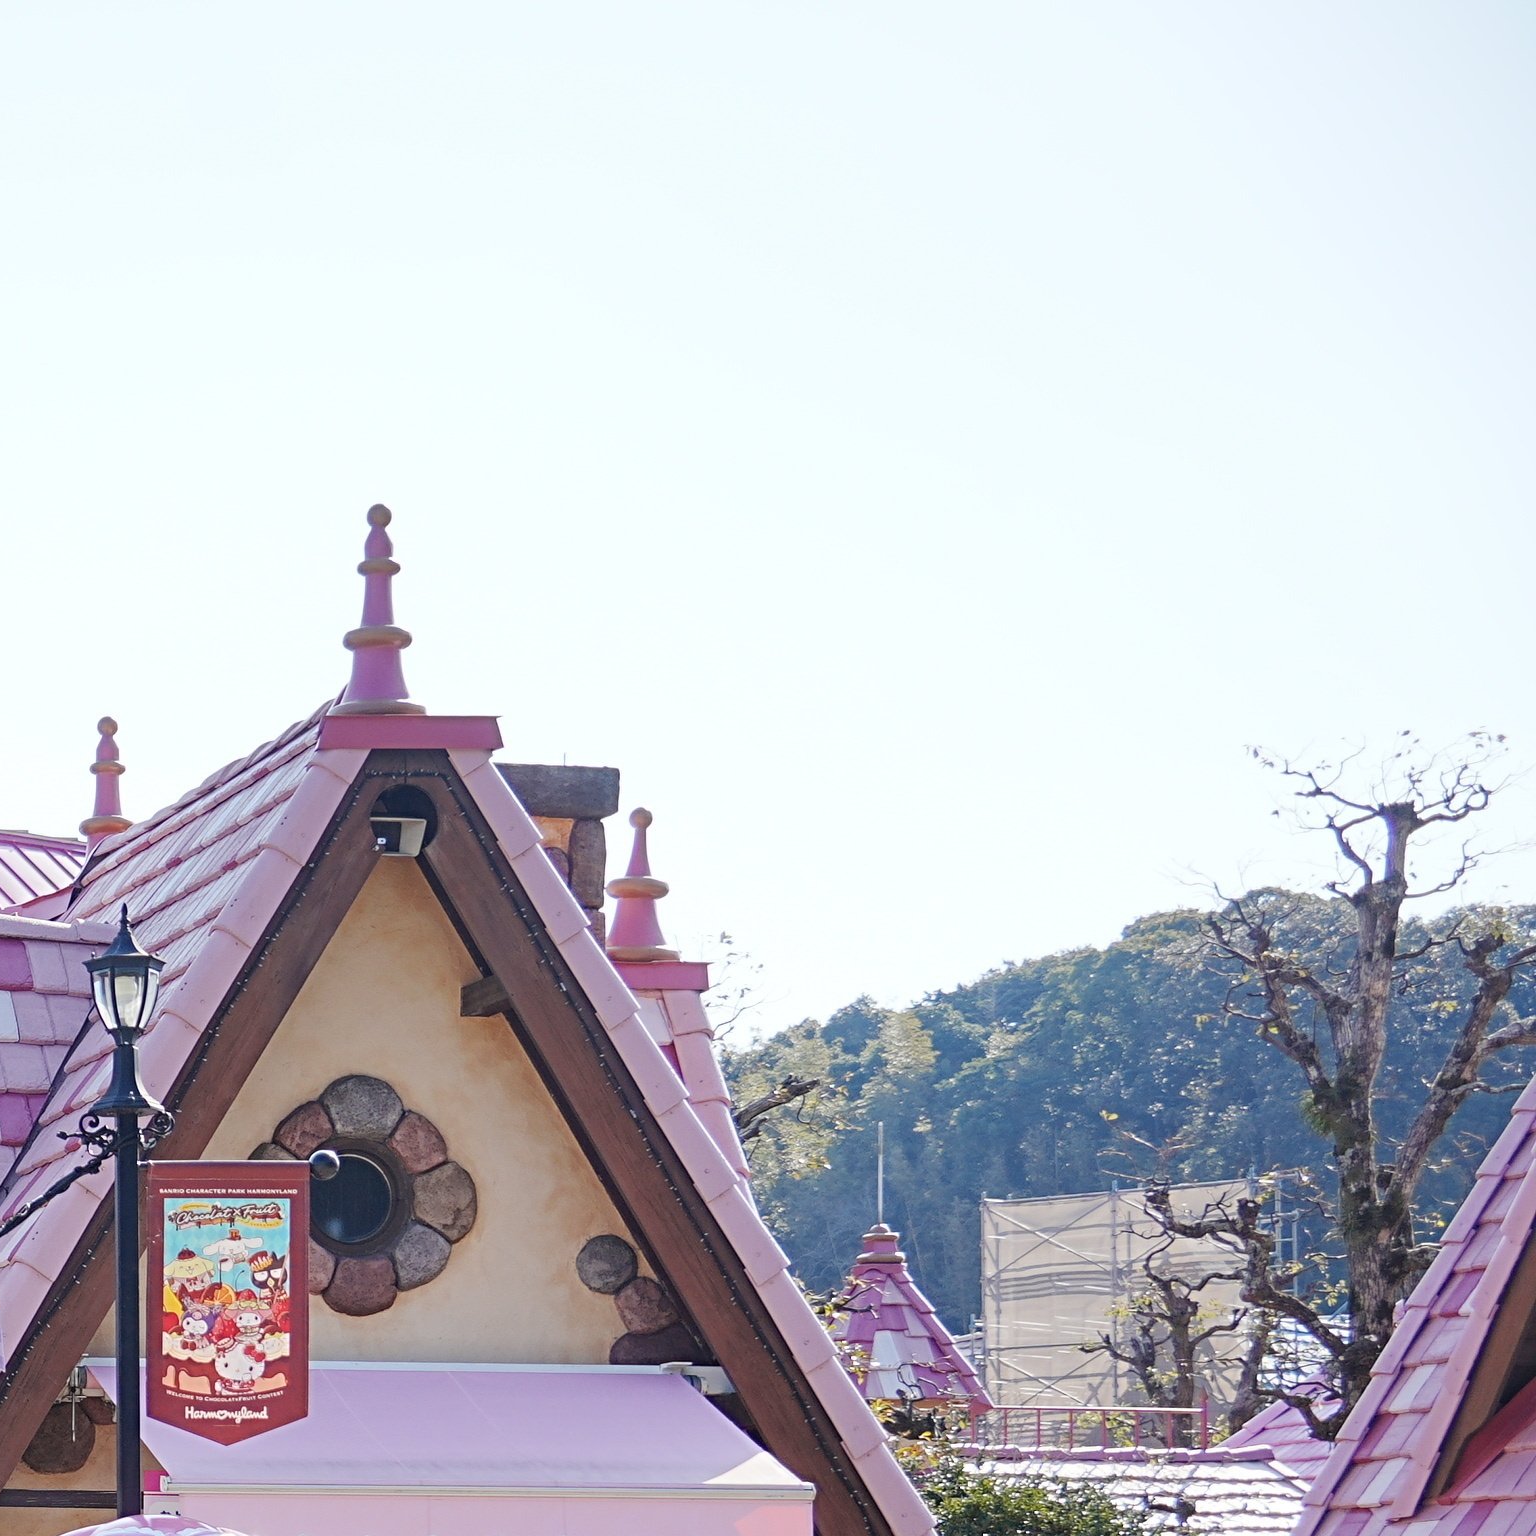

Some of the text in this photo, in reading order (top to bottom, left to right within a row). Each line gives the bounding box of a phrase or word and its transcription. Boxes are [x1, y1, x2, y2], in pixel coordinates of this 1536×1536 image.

[176, 1207, 231, 1224] Chocolat
[241, 1202, 276, 1218] Fruit
[185, 1406, 269, 1424] Harmonyland
